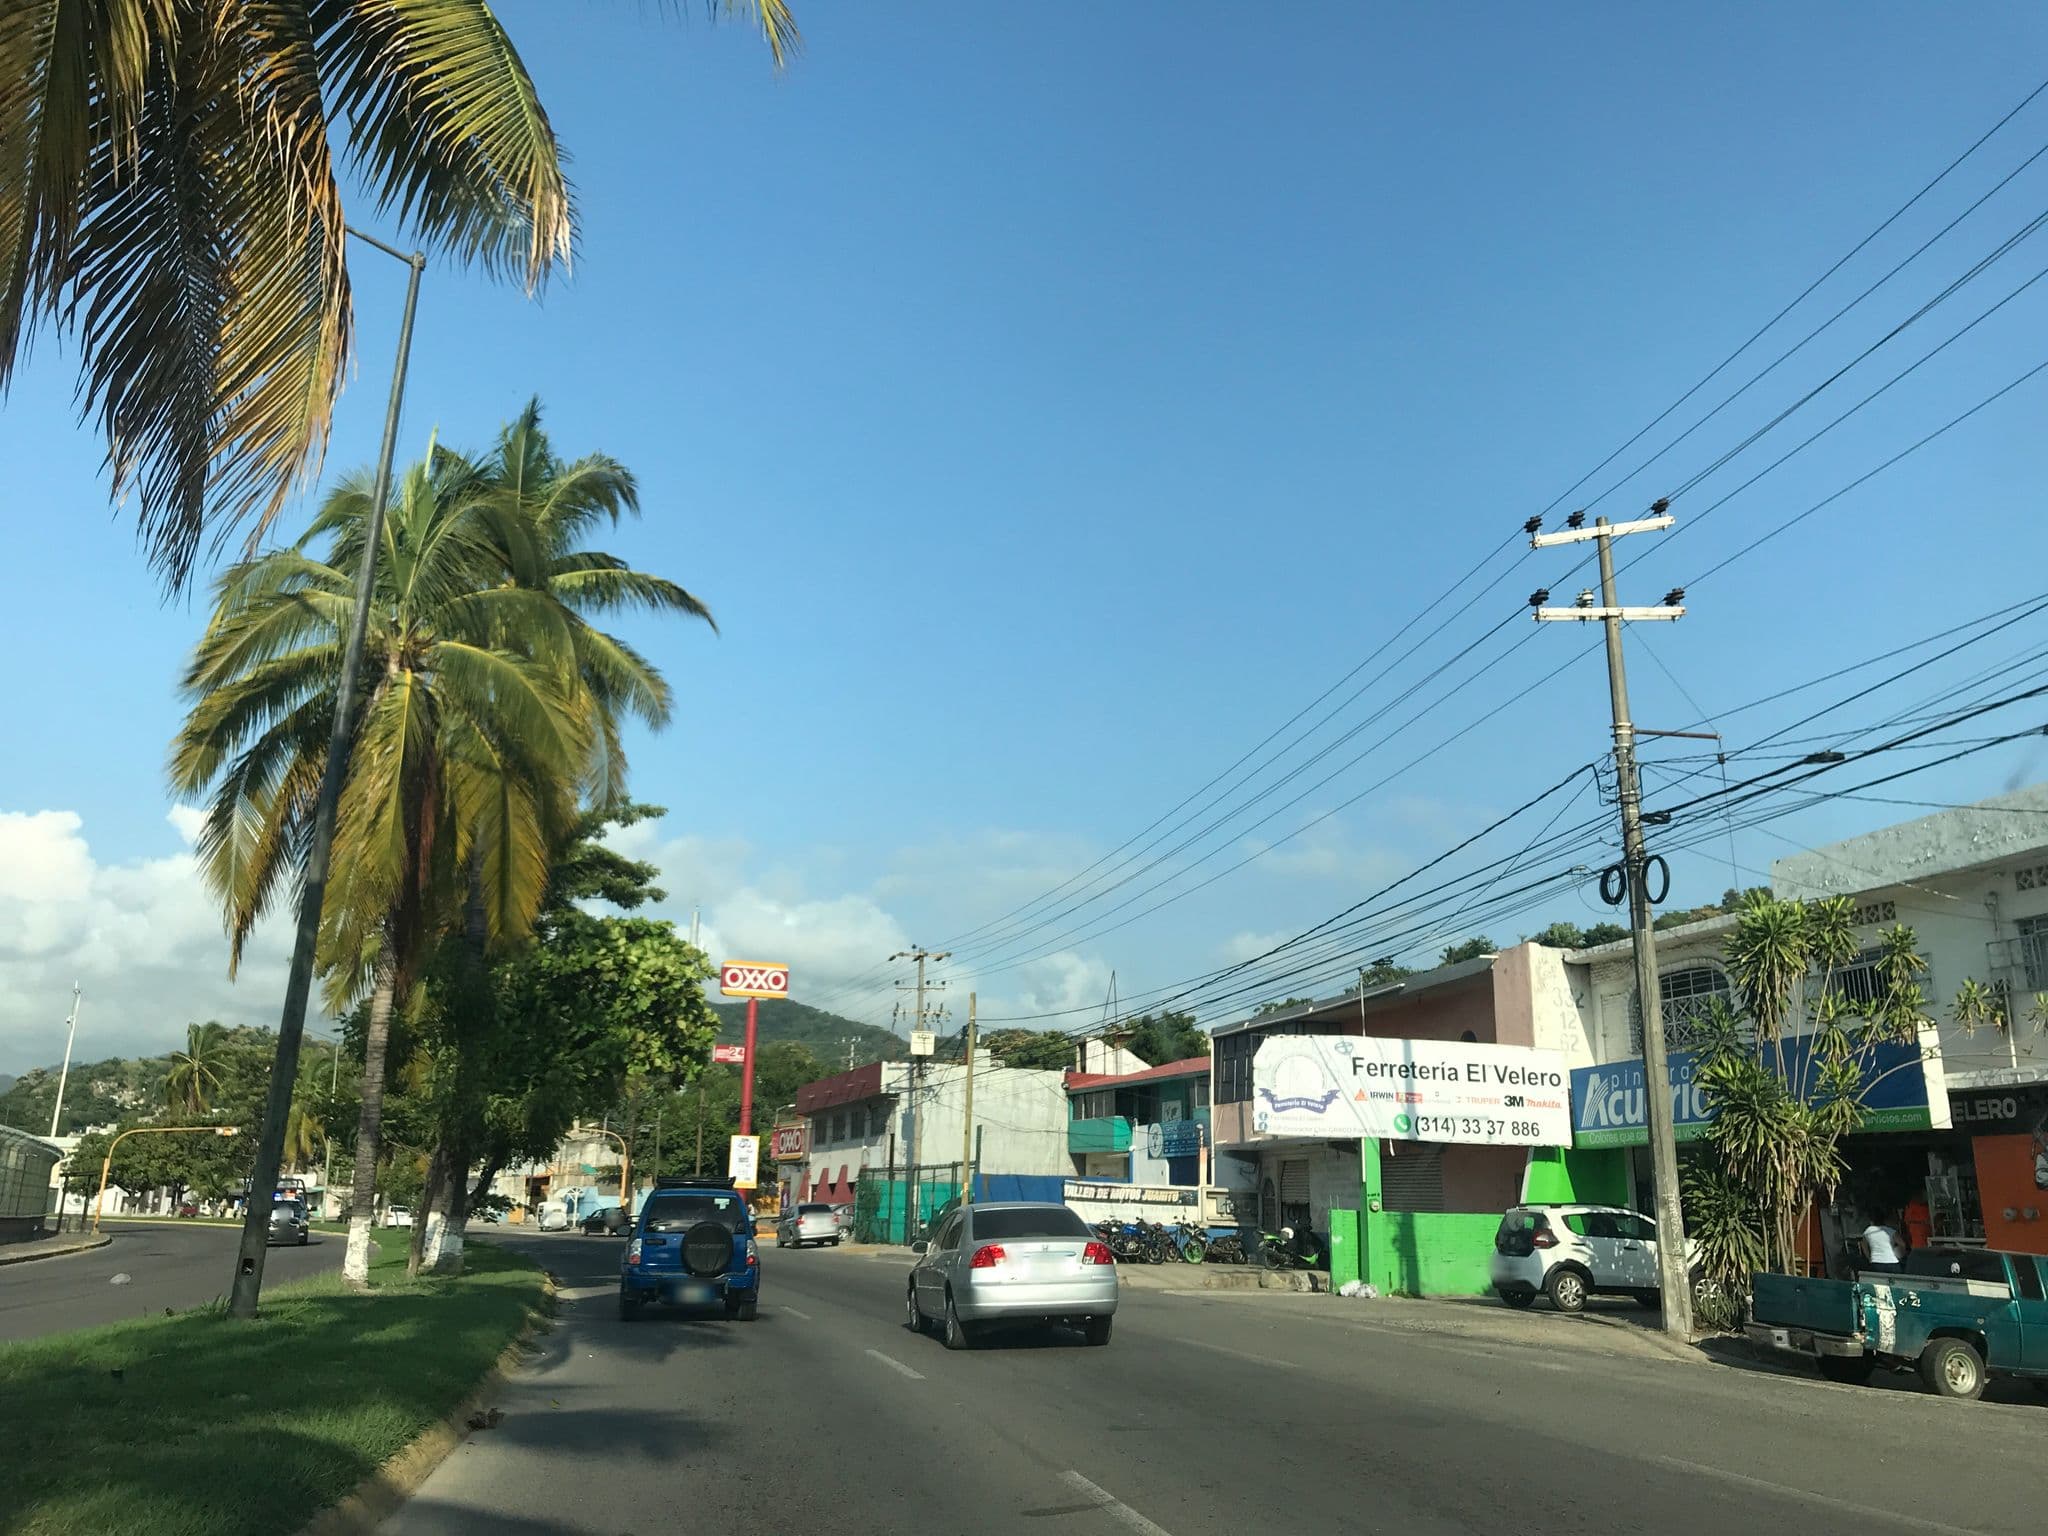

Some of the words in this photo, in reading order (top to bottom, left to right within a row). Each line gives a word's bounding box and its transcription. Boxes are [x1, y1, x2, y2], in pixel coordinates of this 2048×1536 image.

[725, 968, 786, 990] OXXO
[1352, 1056, 1459, 1082] Ferretería
[1467, 1063, 1486, 1083] El
[1493, 1064, 1561, 1087] Velero
[1504, 1095, 1524, 1108] 3M
[1952, 1097, 2017, 1121] ELERO
[1415, 1116, 1456, 1136] (314)
[1462, 1118, 1481, 1134] 33
[1487, 1120, 1505, 1135] 37
[1511, 1121, 1540, 1137] 886
[780, 1130, 801, 1152] OXXO
[1097, 1186, 1109, 1200] DE
